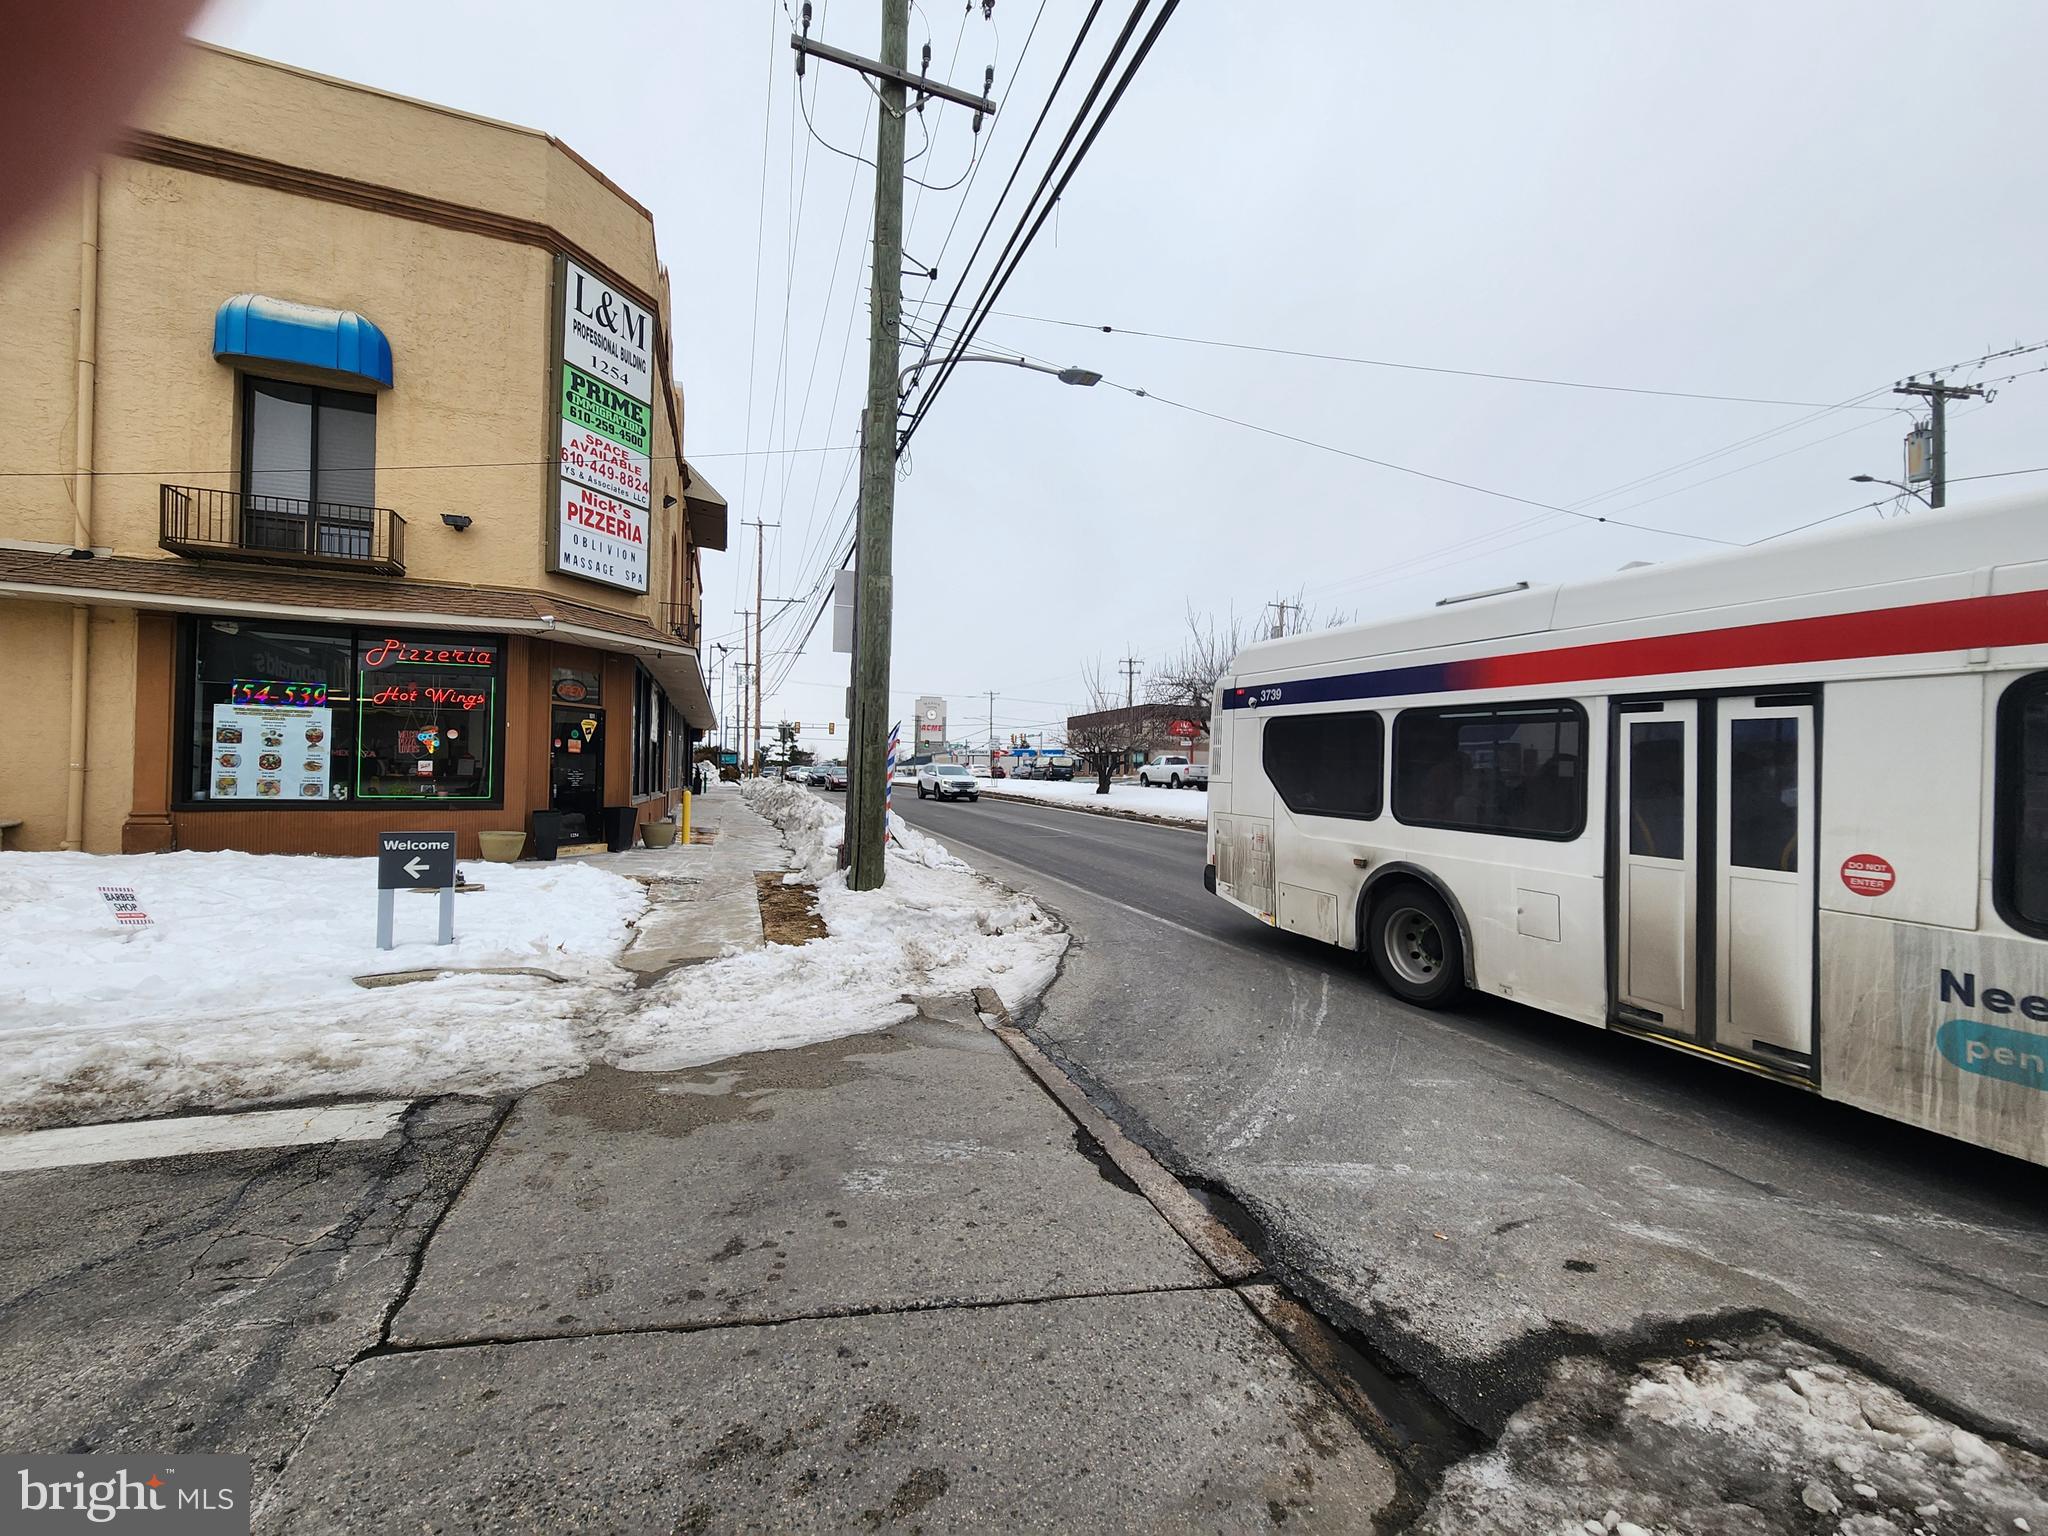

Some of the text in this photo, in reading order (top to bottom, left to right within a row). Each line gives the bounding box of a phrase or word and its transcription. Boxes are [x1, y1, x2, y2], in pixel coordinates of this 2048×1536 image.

[574, 271, 646, 351] L&M
[573, 318, 646, 373] PROFESSIONAL BUILDING
[592, 356, 629, 385] 1254
[571, 371, 643, 424] PRIME
[570, 406, 642, 448] 610-259-4500
[572, 393, 642, 433] IMMIGRATION
[570, 439, 642, 476] AVAILABLE
[585, 434, 629, 460] SPACE
[561, 447, 649, 494] 610-449-8824
[564, 465, 647, 504] YS & Associates LLC
[581, 490, 631, 519] Nick's
[567, 501, 642, 544] PIZZERIA
[573, 534, 636, 563] OBLIVION
[564, 551, 643, 585] MASSAGE SPA
[366, 639, 492, 667] Pizzeria
[374, 686, 485, 710] Hot Wings
[557, 683, 585, 697] OPEN
[1260, 688, 1282, 702] 3739
[384, 839, 450, 851] Welcome
[1848, 861, 1887, 872] DO NOT
[103, 893, 137, 902] BARBER
[1850, 878, 1885, 888] ENTER
[113, 903, 138, 911] SHOP
